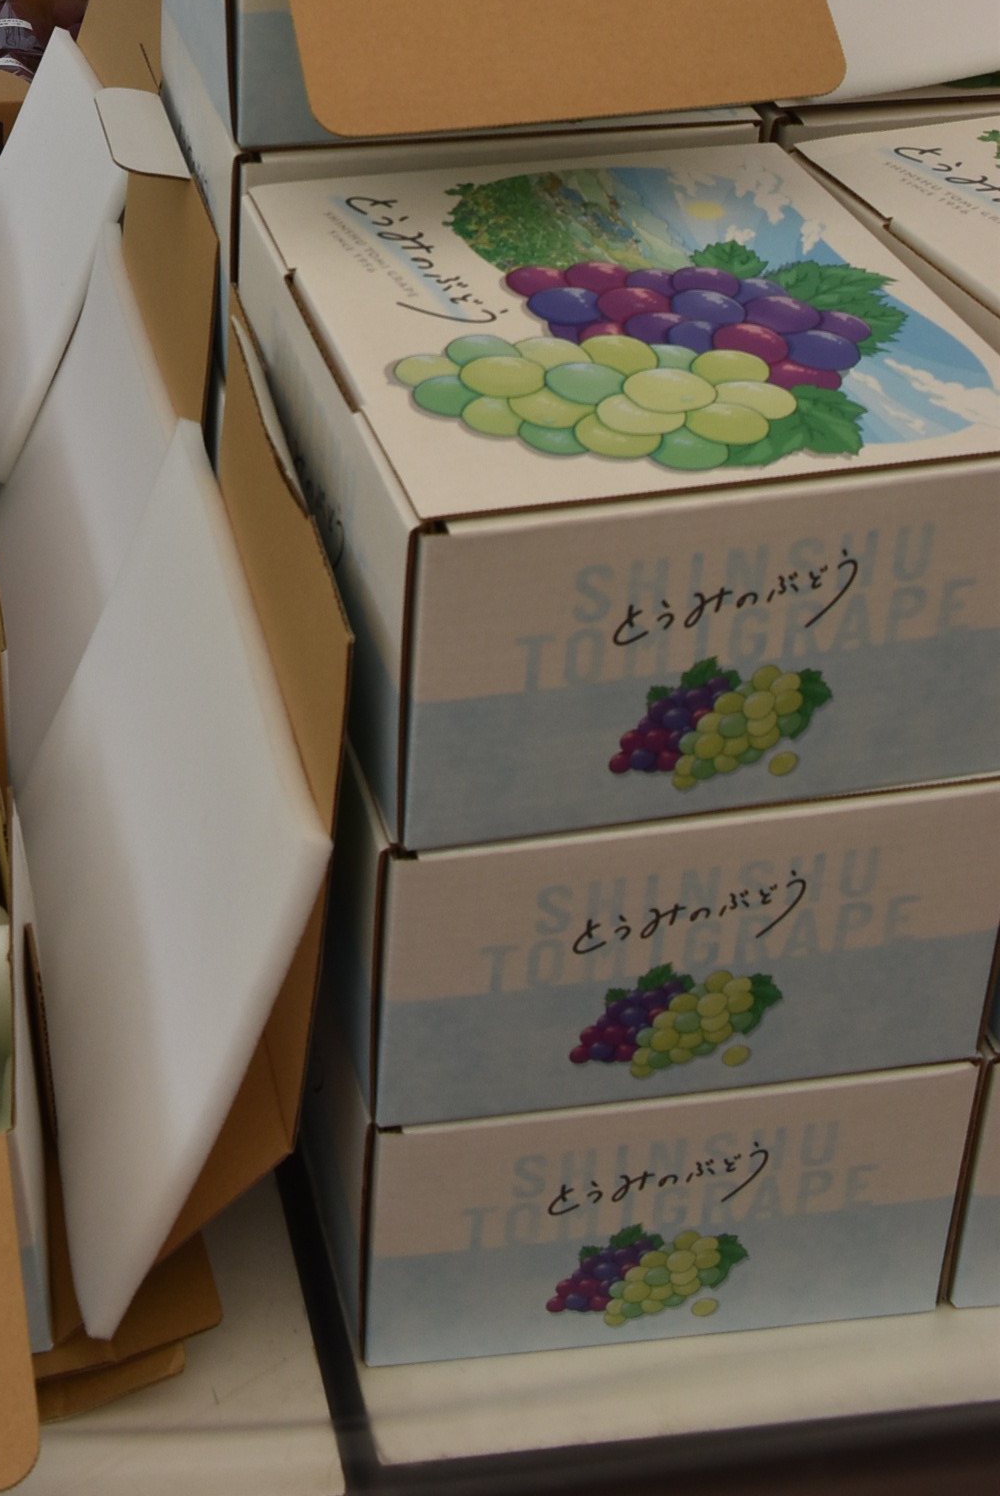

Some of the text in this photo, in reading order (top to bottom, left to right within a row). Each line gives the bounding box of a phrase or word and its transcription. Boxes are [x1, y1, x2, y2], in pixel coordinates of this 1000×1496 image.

[612, 549, 858, 646] とうみのぶどう
[572, 870, 808, 954] とうみのぶどう
[547, 1141, 770, 1216] とうみのぶどう
